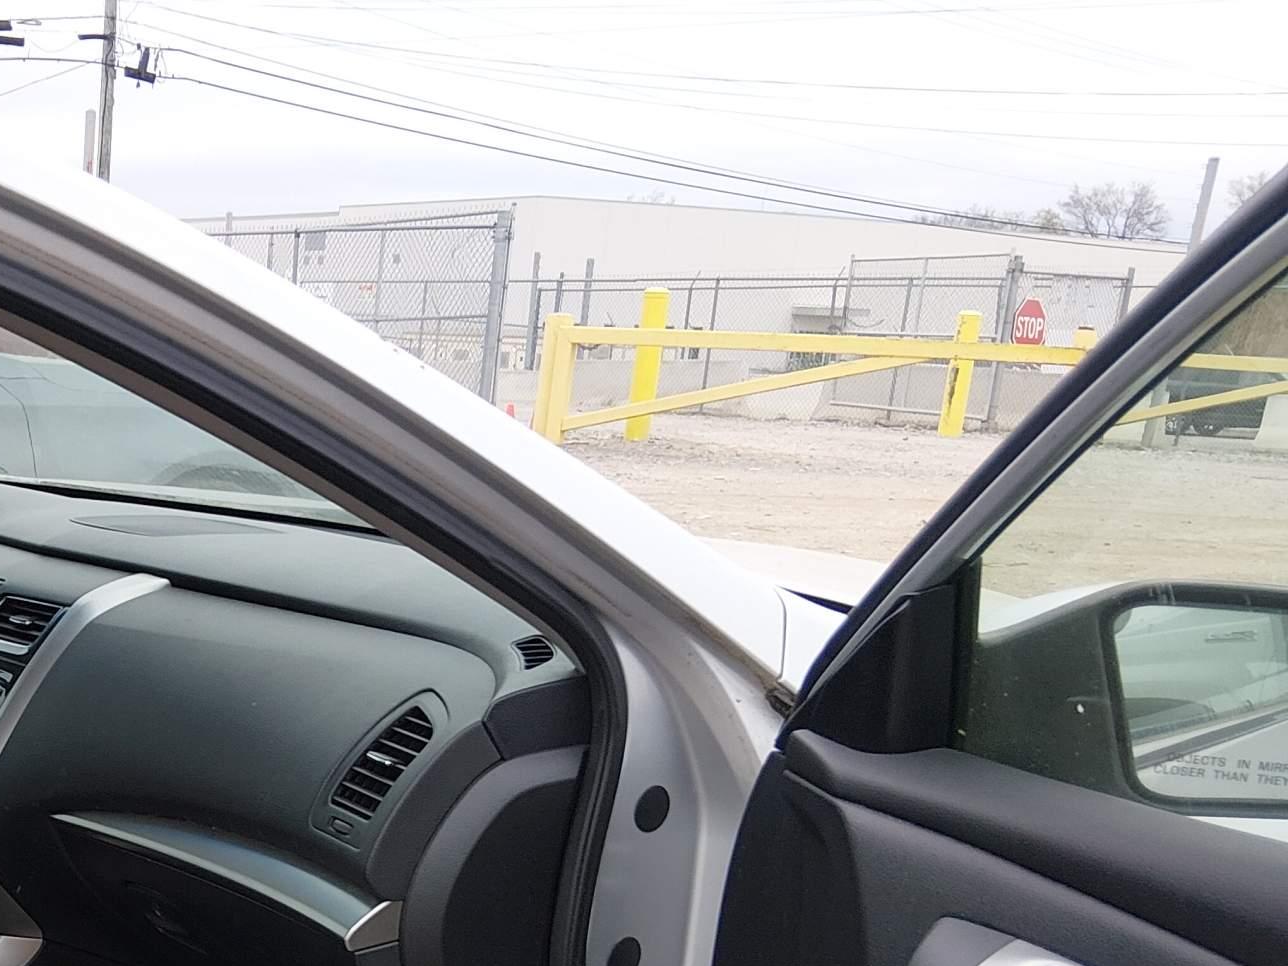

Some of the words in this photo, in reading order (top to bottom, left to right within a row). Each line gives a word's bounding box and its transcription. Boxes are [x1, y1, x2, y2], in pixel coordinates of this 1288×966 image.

[1016, 316, 1044, 339] STOP
[1167, 751, 1227, 768] OBJECTS
[1237, 759, 1252, 770] IN
[1153, 763, 1206, 778] CLOSER
[1213, 769, 1249, 783] THAN
